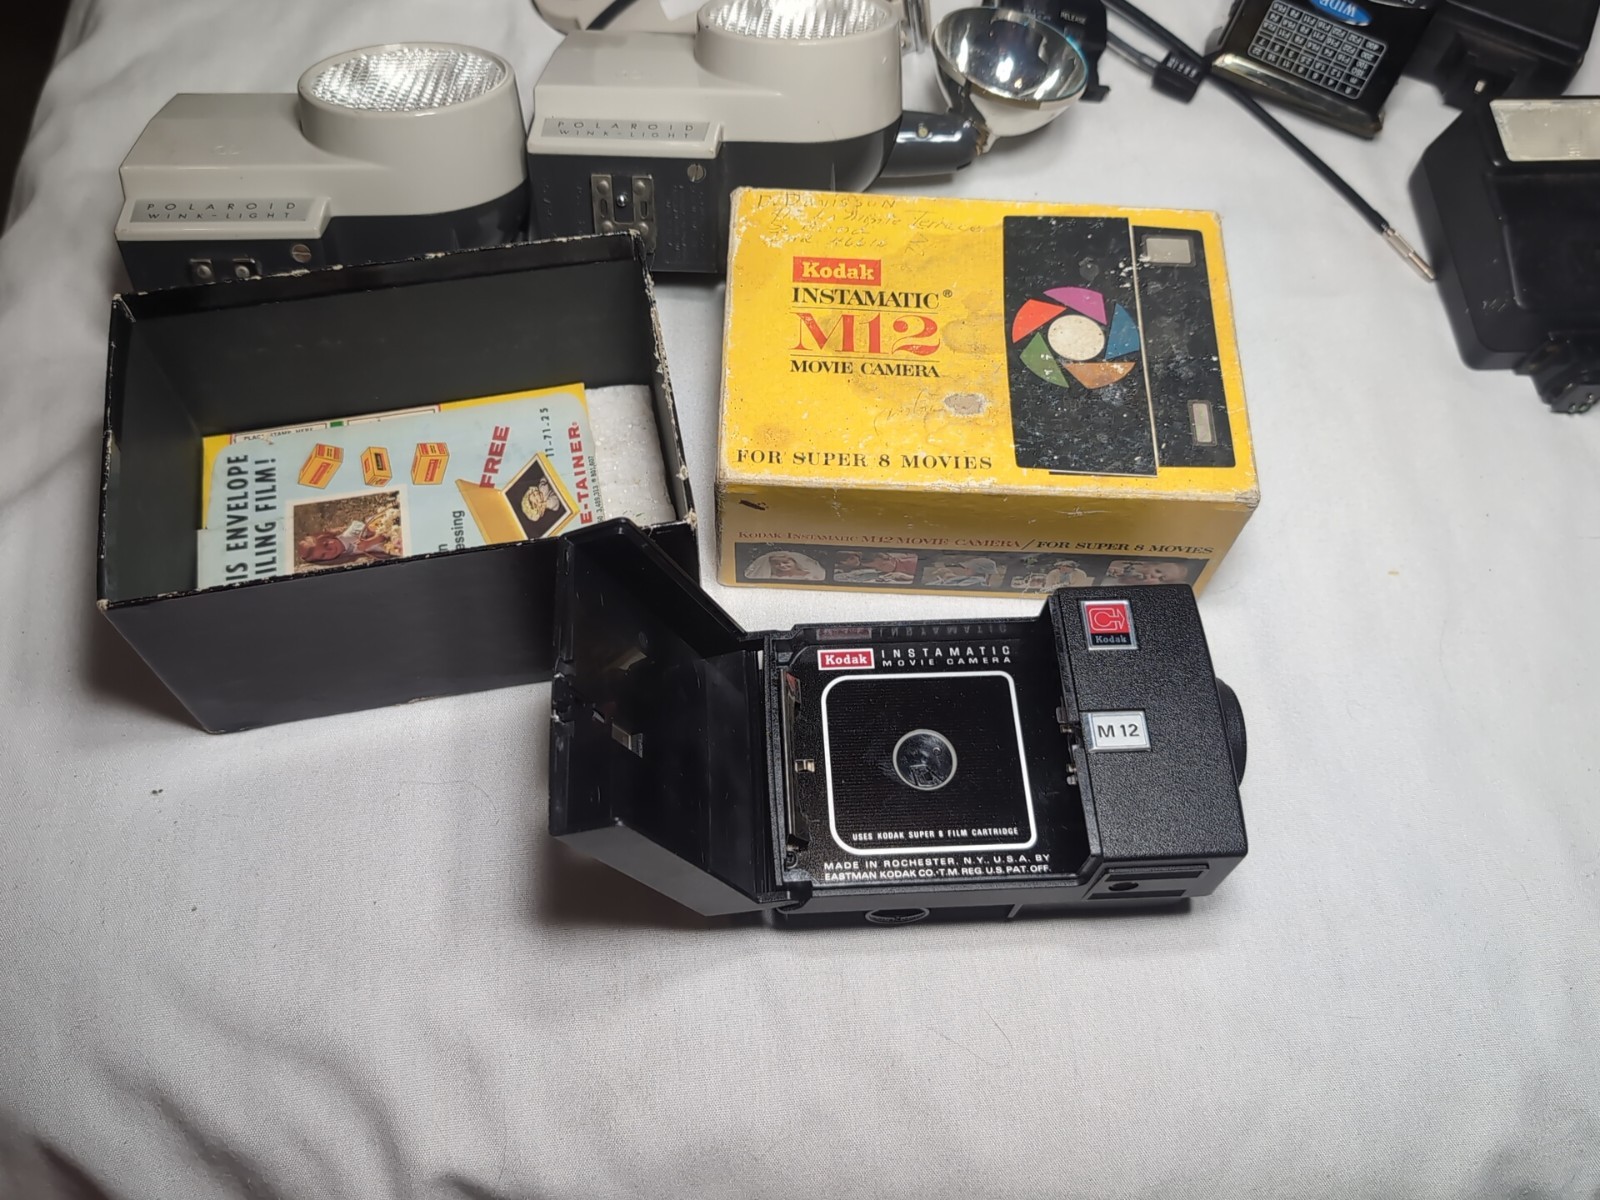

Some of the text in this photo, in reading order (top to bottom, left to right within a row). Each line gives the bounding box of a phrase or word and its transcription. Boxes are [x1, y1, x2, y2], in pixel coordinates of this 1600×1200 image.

[1269, 13, 1279, 21] F4
[1302, 15, 1316, 25] F11
[1278, 29, 1290, 38] F11
[1312, 31, 1325, 40] F11
[1331, 27, 1346, 37] F22
[1252, 46, 1261, 54] 22
[1341, 43, 1356, 53] F22
[1282, 59, 1290, 67] 11
[558, 121, 694, 132] POLAROID
[559, 130, 689, 139] WINK-LIGHT
[147, 202, 296, 211] POLAROID
[802, 261, 875, 280] Kodak
[789, 312, 941, 356] M12
[790, 360, 941, 377] MOVIE CAMERA
[540, 407, 555, 458] 11-71-25
[479, 425, 511, 489] FREE
[736, 449, 993, 469] FOR SUPER 8 MOVIES
[226, 455, 249, 551] ENVELOPE
[255, 458, 277, 577] ILING FILM!
[451, 510, 465, 551] essing
[738, 531, 782, 539] KODAK
[861, 535, 894, 544] M12
[898, 537, 949, 546] MOVIE
[1075, 542, 1131, 551] SUPER
[1134, 543, 1145, 551] 8
[1148, 545, 1214, 554] MOVIES
[1095, 634, 1127, 644] Kodak
[881, 646, 1010, 659] INSTAMATIC
[825, 654, 868, 665] Kodak
[882, 656, 1011, 667] MOVIE CAMERA
[1097, 723, 1140, 738] M 12
[852, 827, 1018, 841] USES KODAK SUPER 8 FILM CARTRIDGE
[824, 861, 859, 871] MADE
[865, 860, 877, 869] IN
[1035, 854, 1050, 862] BY
[825, 871, 877, 881] EASTMAN
[879, 869, 917, 879] KODAK
[1006, 865, 1030, 874] PAT.
[1030, 864, 1052, 873] OFF.
